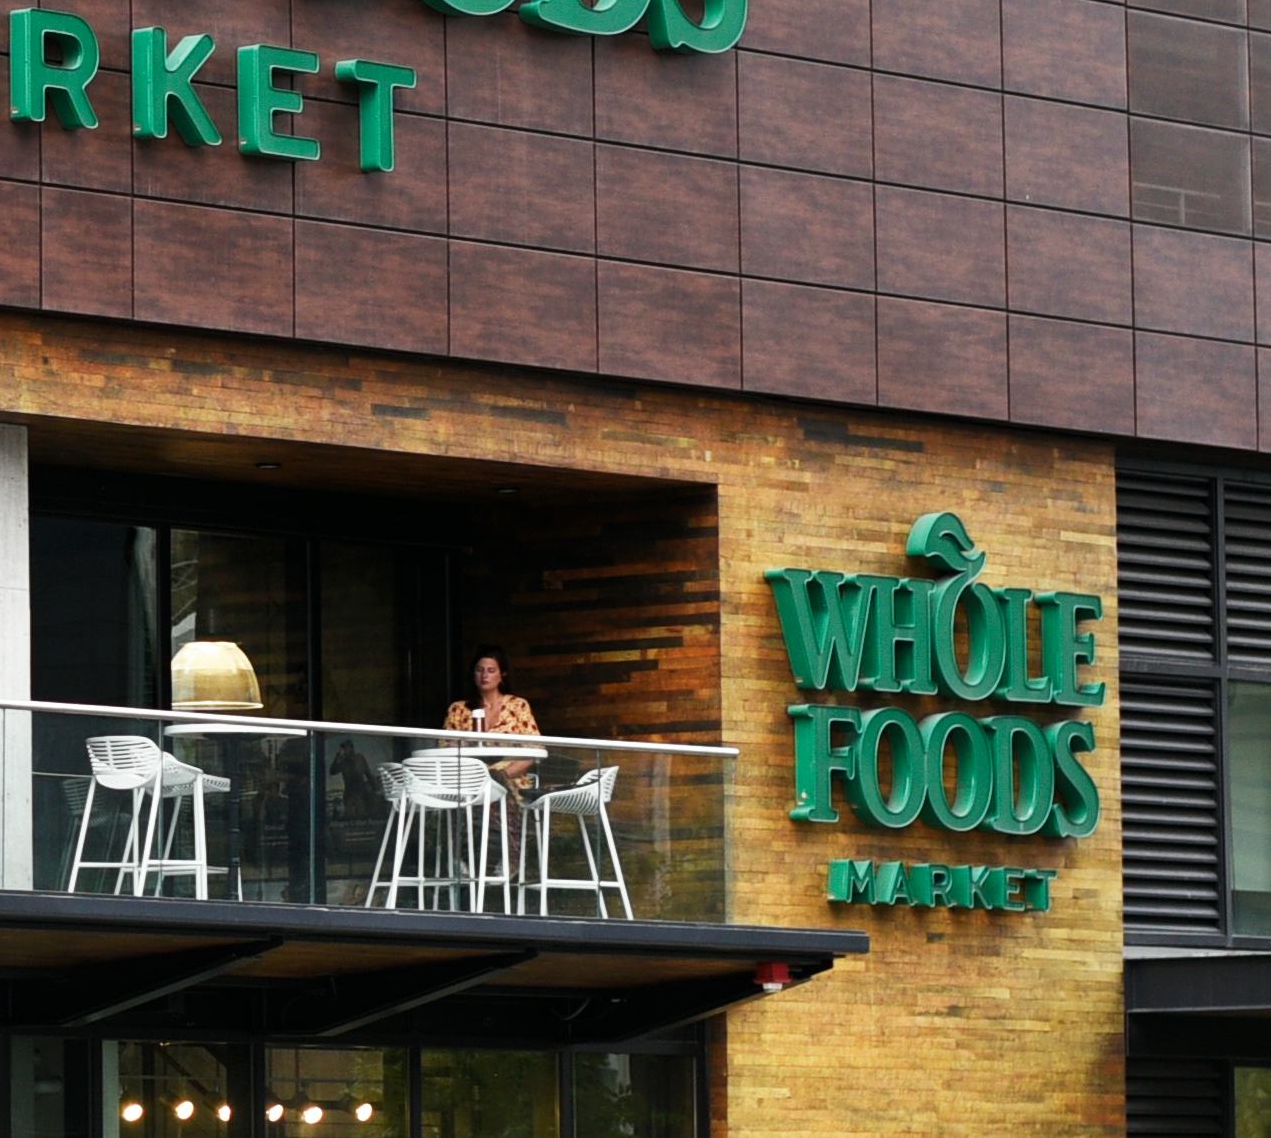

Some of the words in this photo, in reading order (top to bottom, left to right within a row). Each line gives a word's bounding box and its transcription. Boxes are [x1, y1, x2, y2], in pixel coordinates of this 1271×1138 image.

[764, 512, 1106, 706] WHOLE
[787, 704, 1100, 838] FOODS
[827, 859, 1058, 912] MARKET
